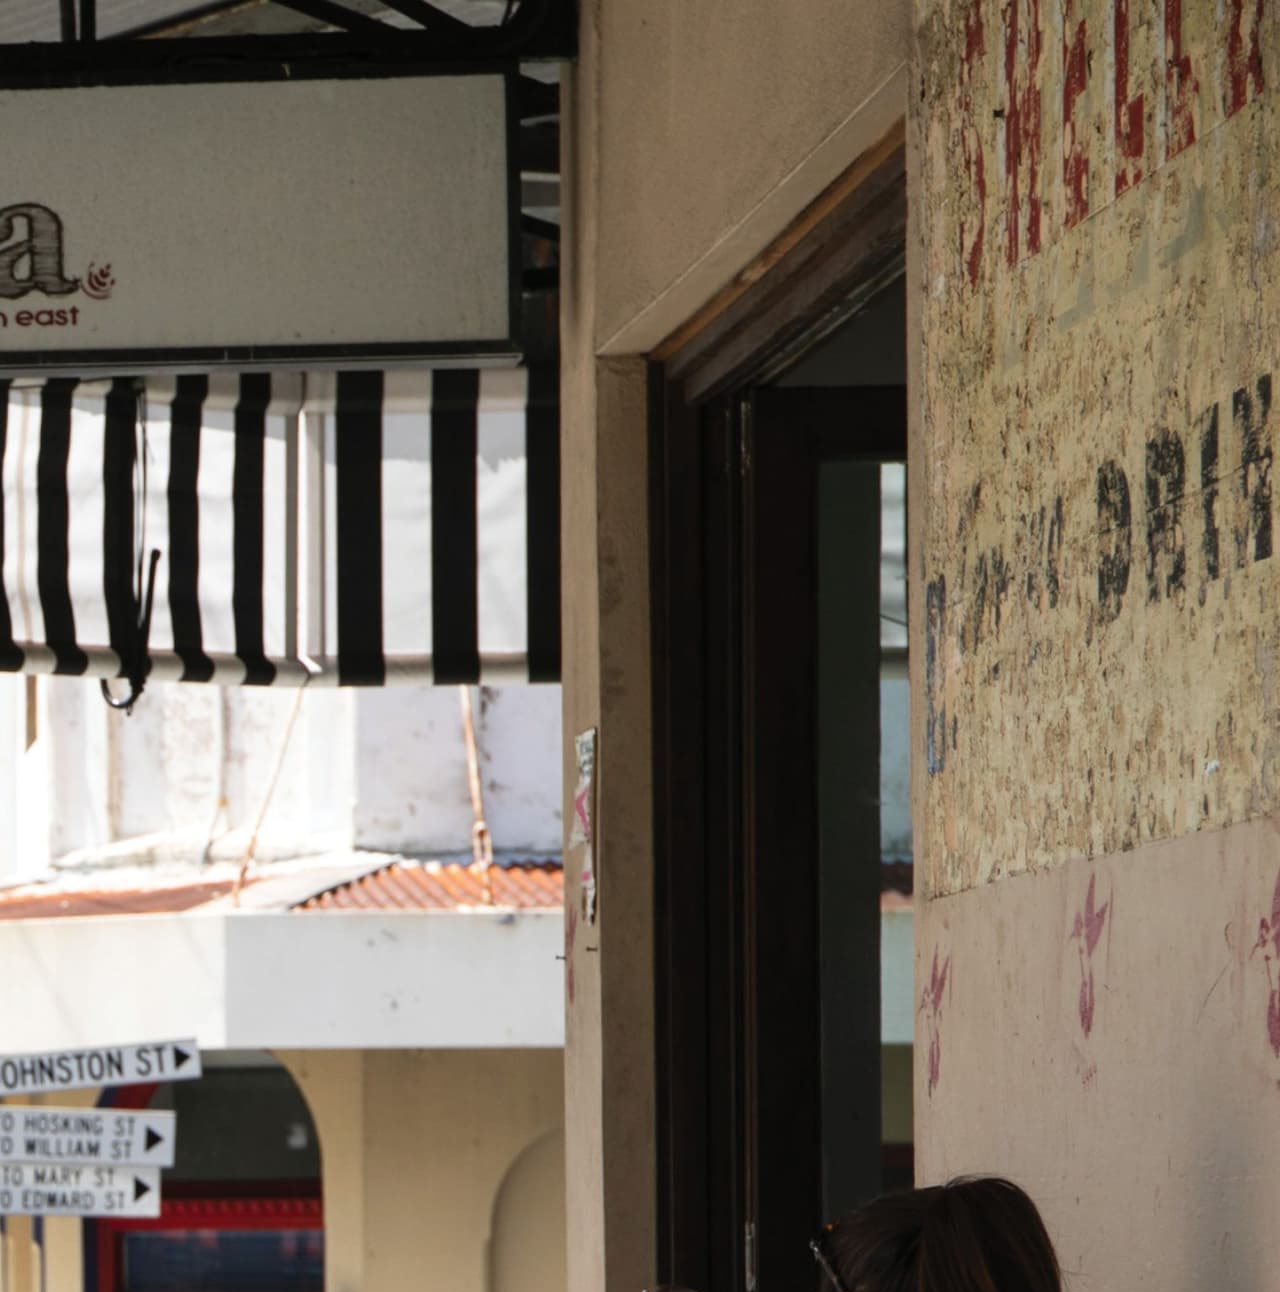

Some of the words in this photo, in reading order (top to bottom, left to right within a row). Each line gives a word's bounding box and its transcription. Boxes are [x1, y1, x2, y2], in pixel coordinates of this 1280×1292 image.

[15, 306, 81, 327] east
[136, 1045, 166, 1076] ST
[24, 1114, 104, 1136] HOSKING
[114, 1116, 136, 1137] ST
[24, 1138, 100, 1157] WILLIAM
[111, 1141, 132, 1159] ST
[2, 1167, 24, 1187] TO
[33, 1167, 82, 1187] MARY
[94, 1168, 115, 1187] ST
[21, 1190, 95, 1209] EDWARD
[104, 1191, 125, 1210] ST
